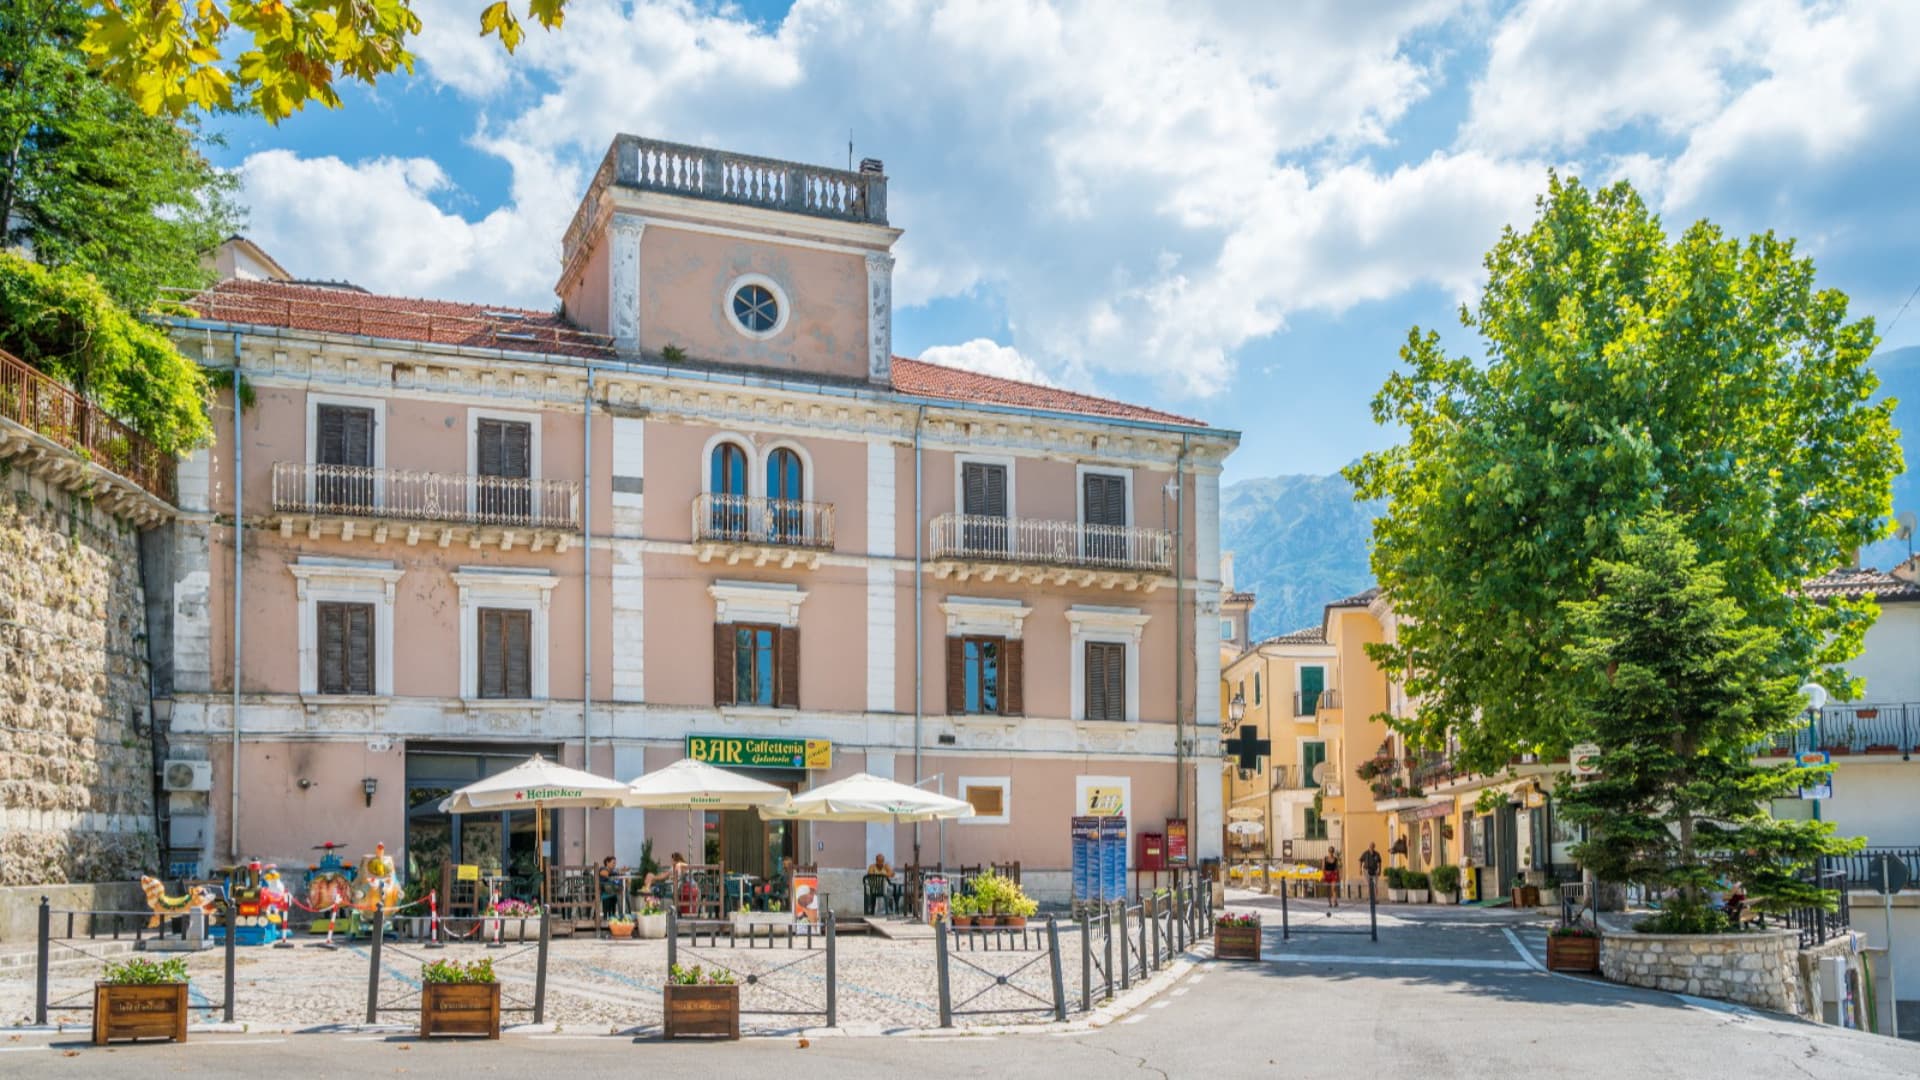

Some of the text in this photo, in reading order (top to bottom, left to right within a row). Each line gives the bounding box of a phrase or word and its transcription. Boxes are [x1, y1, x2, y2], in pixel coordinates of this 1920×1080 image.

[690, 739, 743, 763] BAR
[746, 740, 803, 754] Caffetteria
[751, 754, 790, 764] Gelateria
[527, 788, 582, 800] Heineken
[690, 796, 720, 804] Heineken
